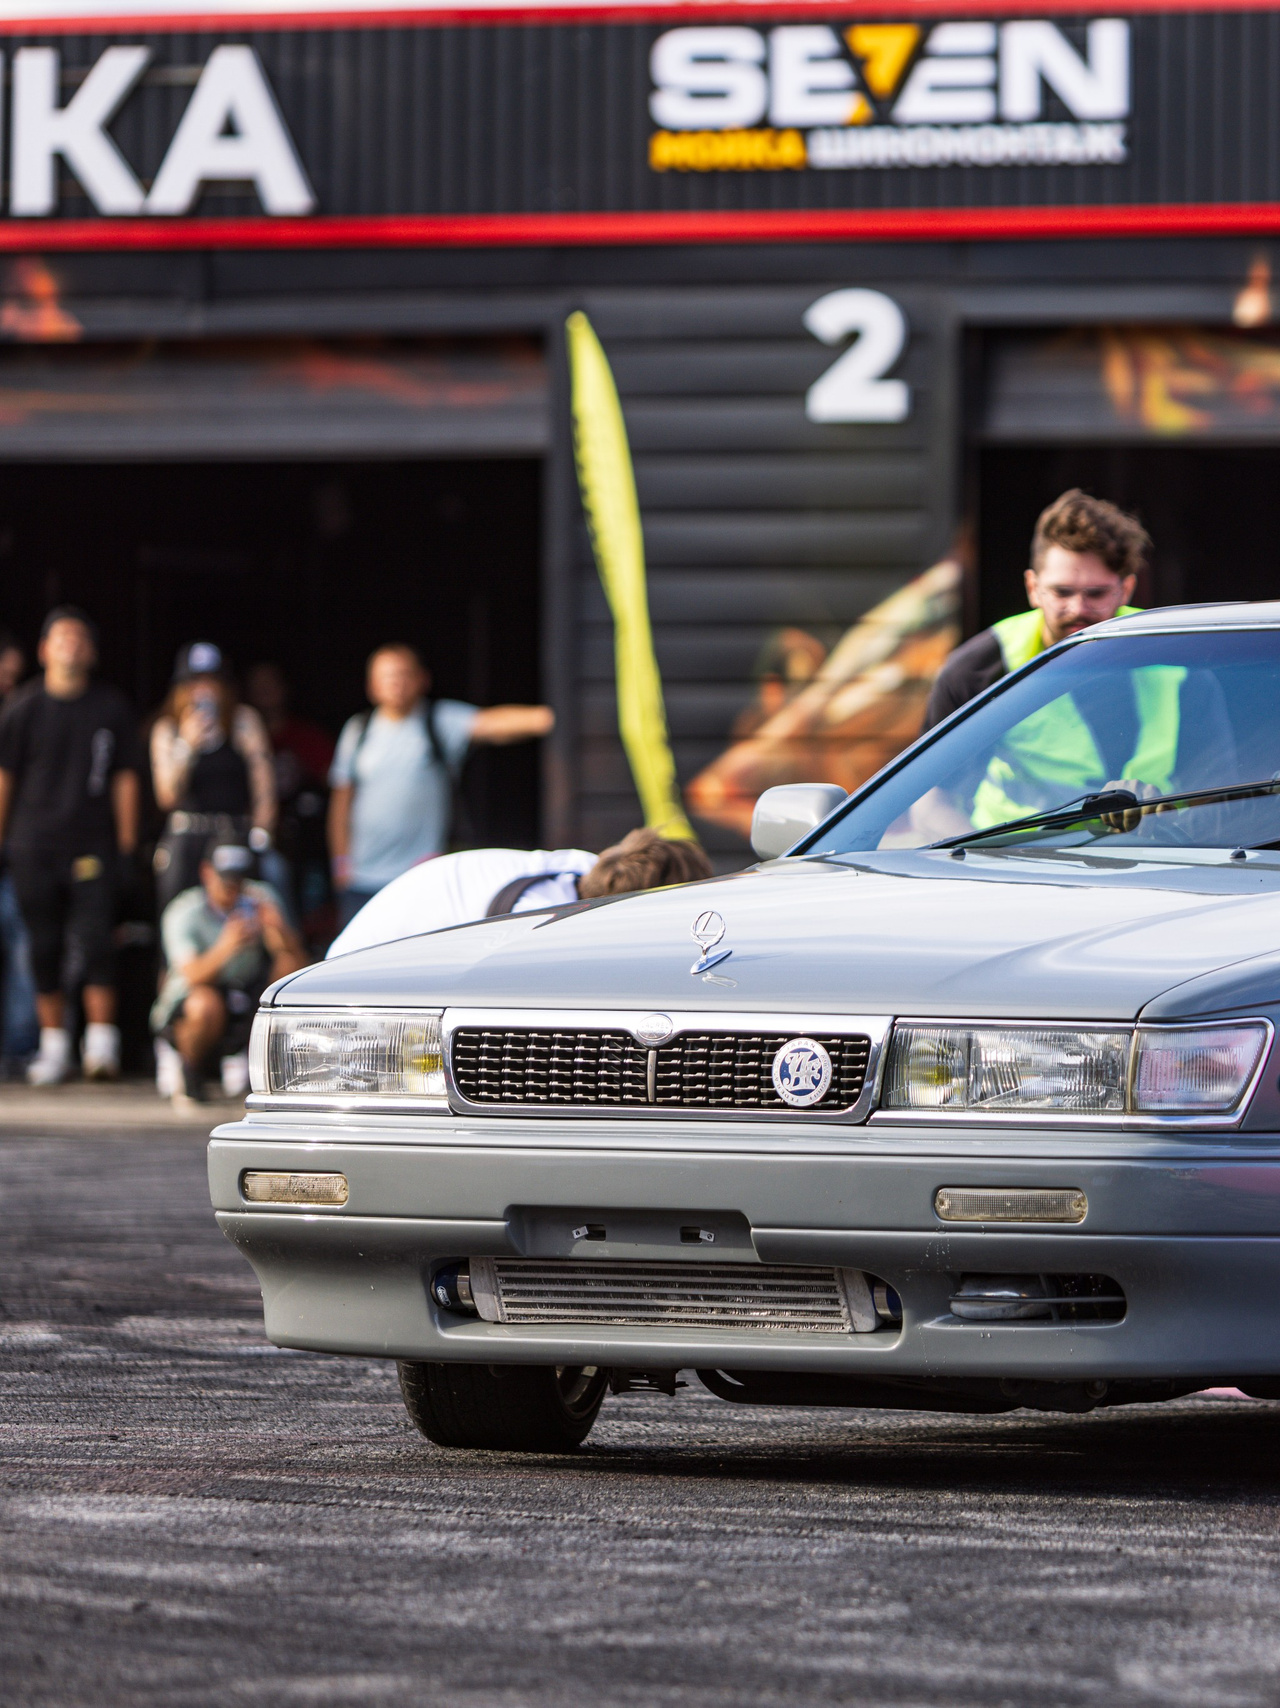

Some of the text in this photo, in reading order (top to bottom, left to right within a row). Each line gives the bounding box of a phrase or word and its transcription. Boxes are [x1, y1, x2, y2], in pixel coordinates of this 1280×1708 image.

[0, 44, 316, 217] КА
[649, 122, 1128, 171] МОЙКА ШИНОМОНТАЖ
[802, 288, 909, 423] 2
